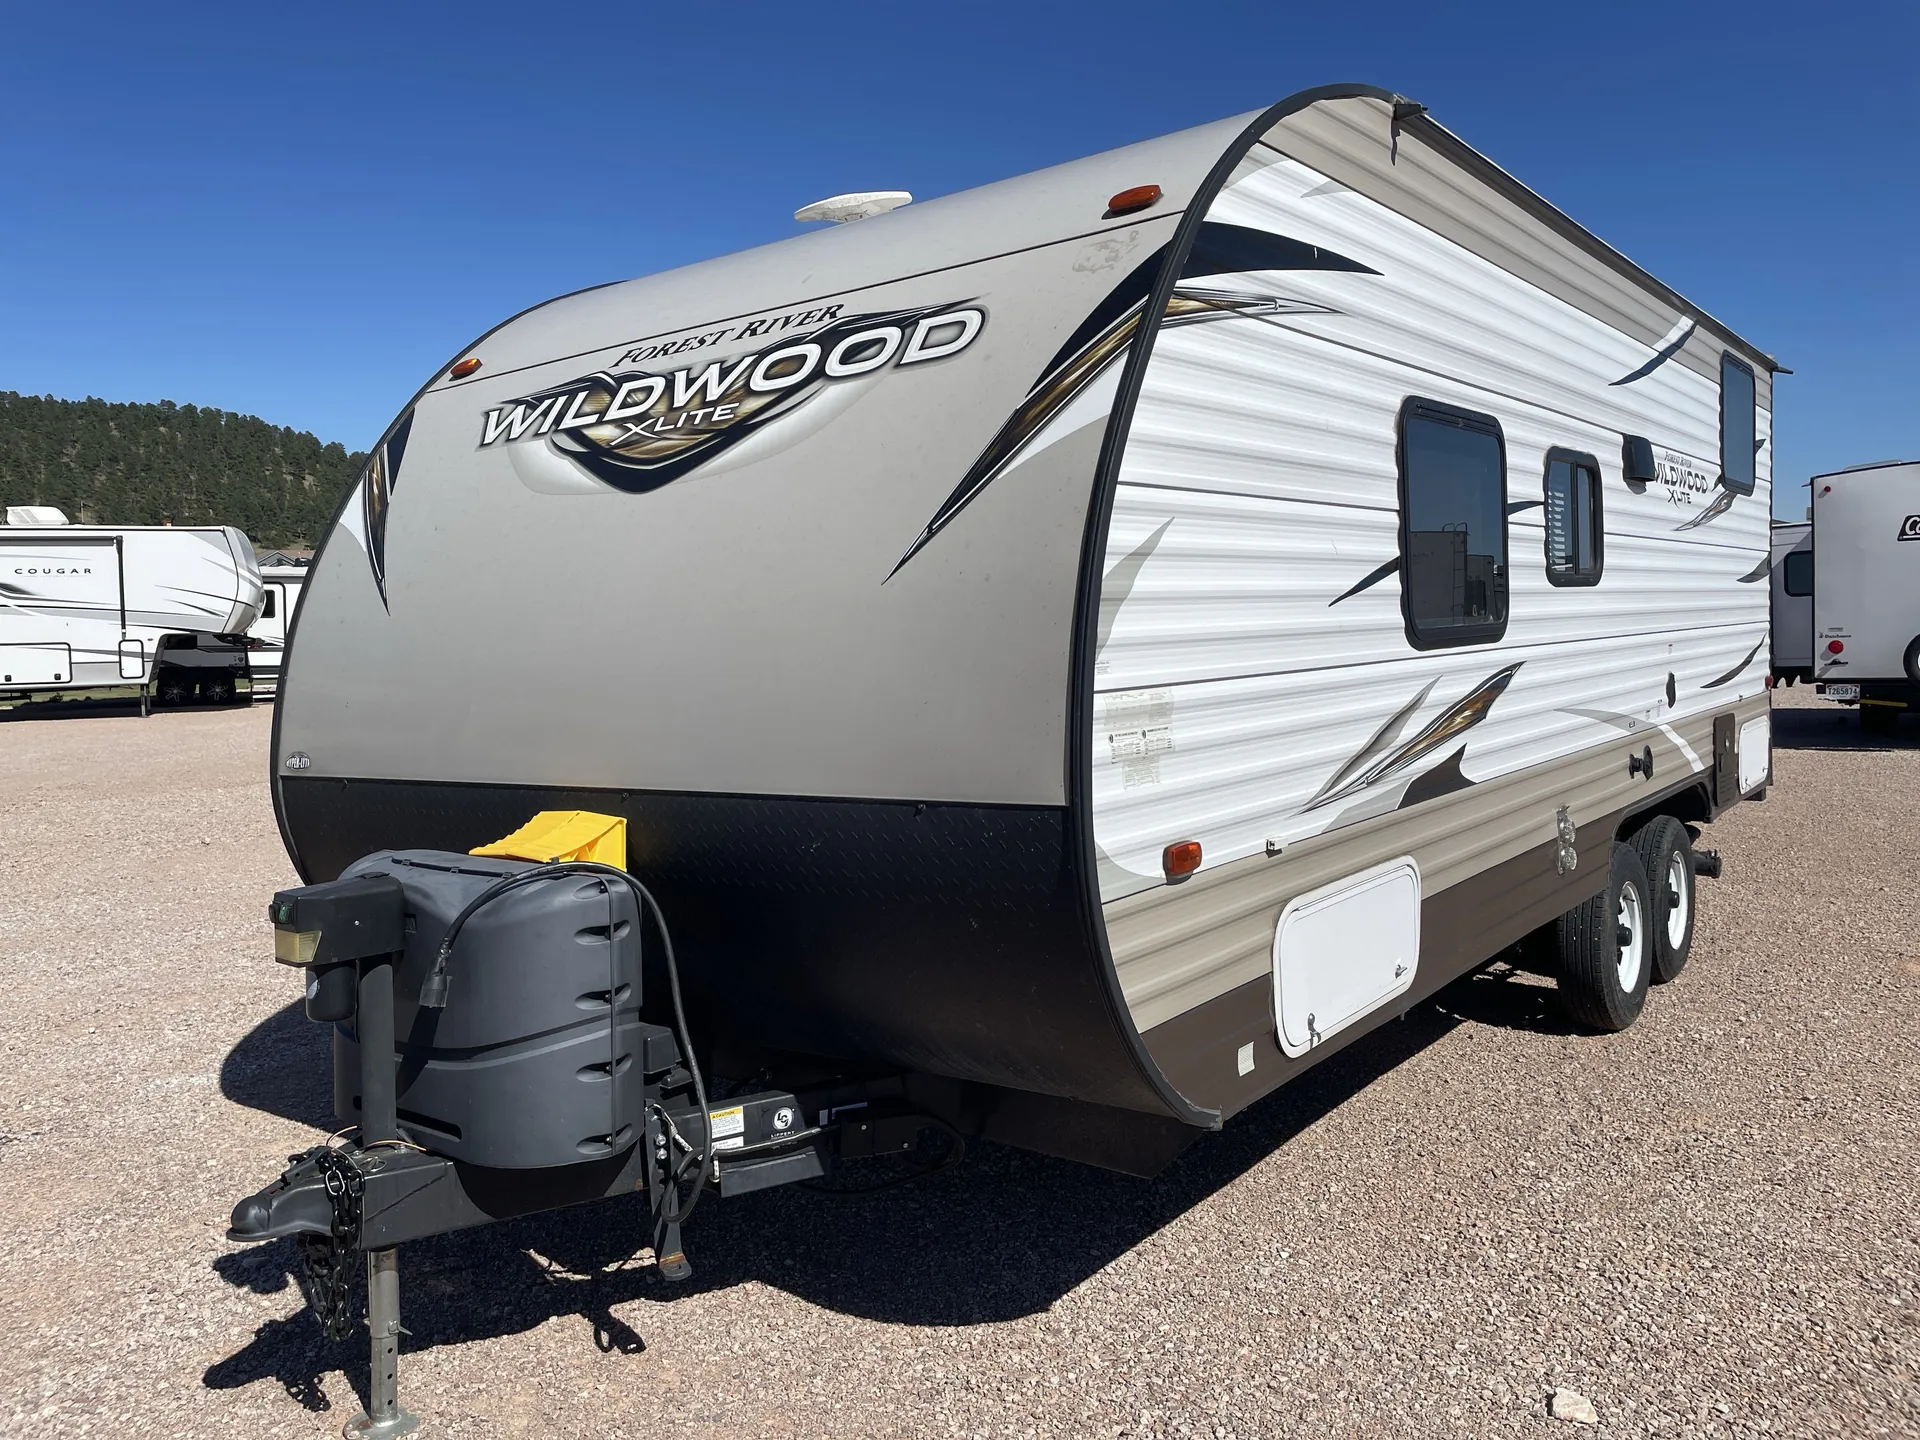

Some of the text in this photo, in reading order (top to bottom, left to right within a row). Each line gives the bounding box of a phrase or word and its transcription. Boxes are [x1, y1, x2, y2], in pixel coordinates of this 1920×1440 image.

[610, 302, 845, 368] FOREST RIVER
[480, 308, 985, 449] WILDWOOD
[610, 401, 740, 446] XLITE
[1828, 687, 1857, 696] T265874
